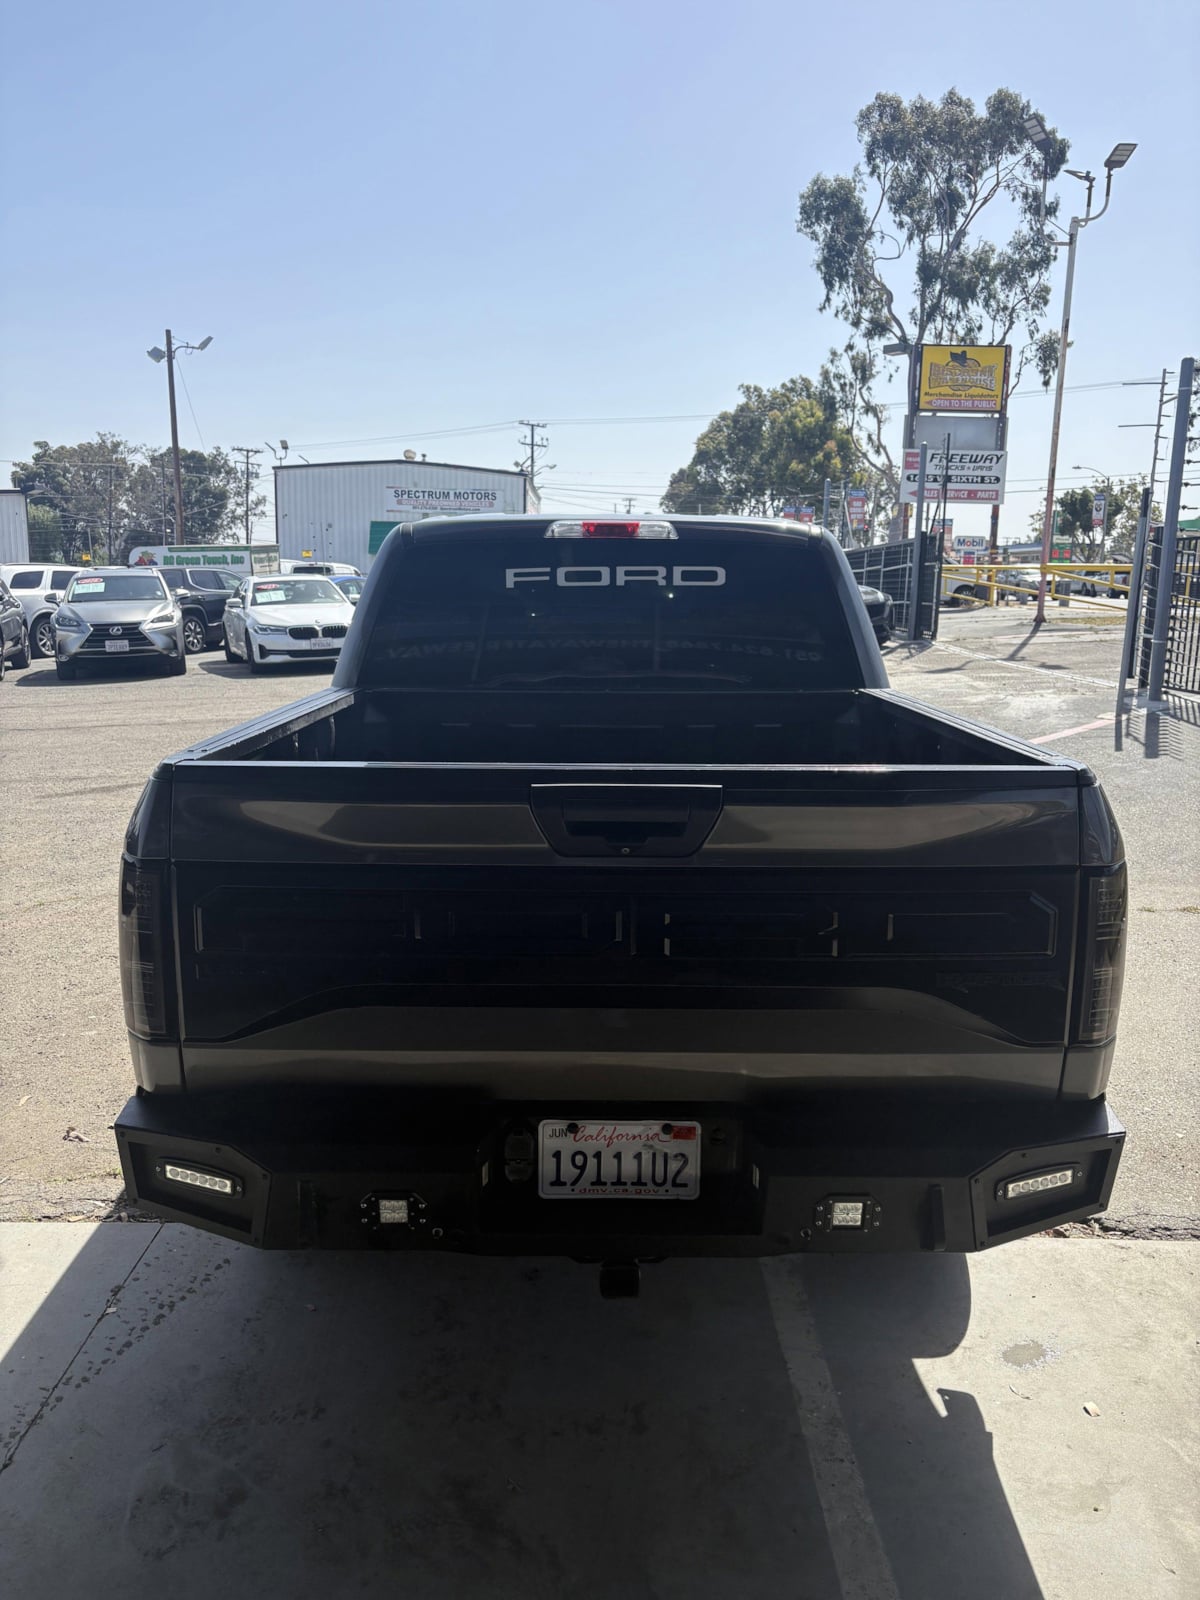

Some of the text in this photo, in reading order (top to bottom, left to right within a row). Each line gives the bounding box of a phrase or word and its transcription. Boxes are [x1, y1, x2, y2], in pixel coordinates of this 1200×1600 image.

[932, 399, 949, 407] OPEN
[974, 400, 996, 408] PUBLIC
[394, 489, 497, 501] SPECTRUM MOTORS
[957, 539, 984, 547] Mobil
[176, 555, 201, 565] Green
[505, 566, 726, 588] FORD
[549, 1127, 568, 1138] JUN
[572, 1125, 671, 1148] California
[549, 1150, 689, 1188] 19111U2
[578, 1187, 660, 1195] dmv.ca.gov
